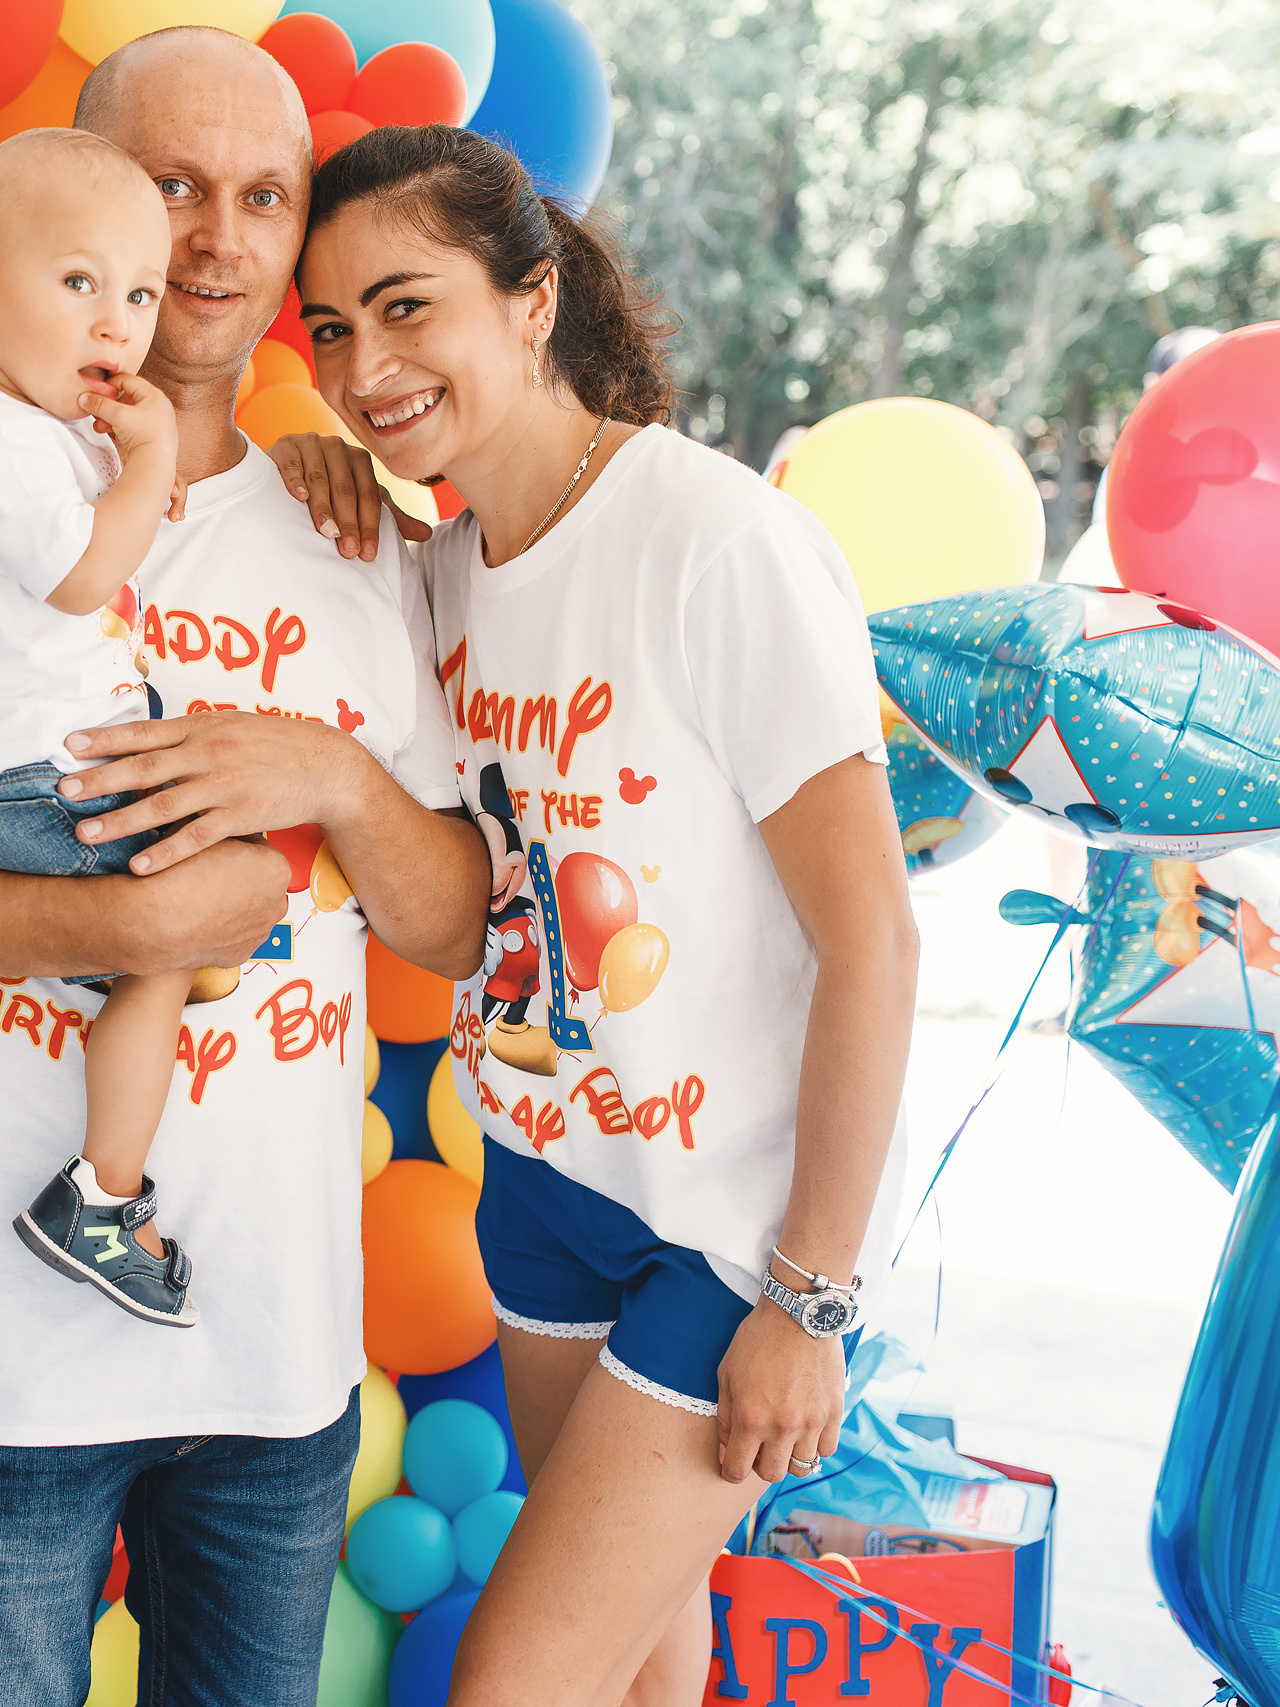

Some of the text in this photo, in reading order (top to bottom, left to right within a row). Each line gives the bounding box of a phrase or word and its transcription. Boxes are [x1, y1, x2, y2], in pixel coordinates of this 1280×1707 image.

[144, 602, 307, 695] ADDY
[540, 787, 604, 835] THE
[710, 1591, 982, 1707] APPY
